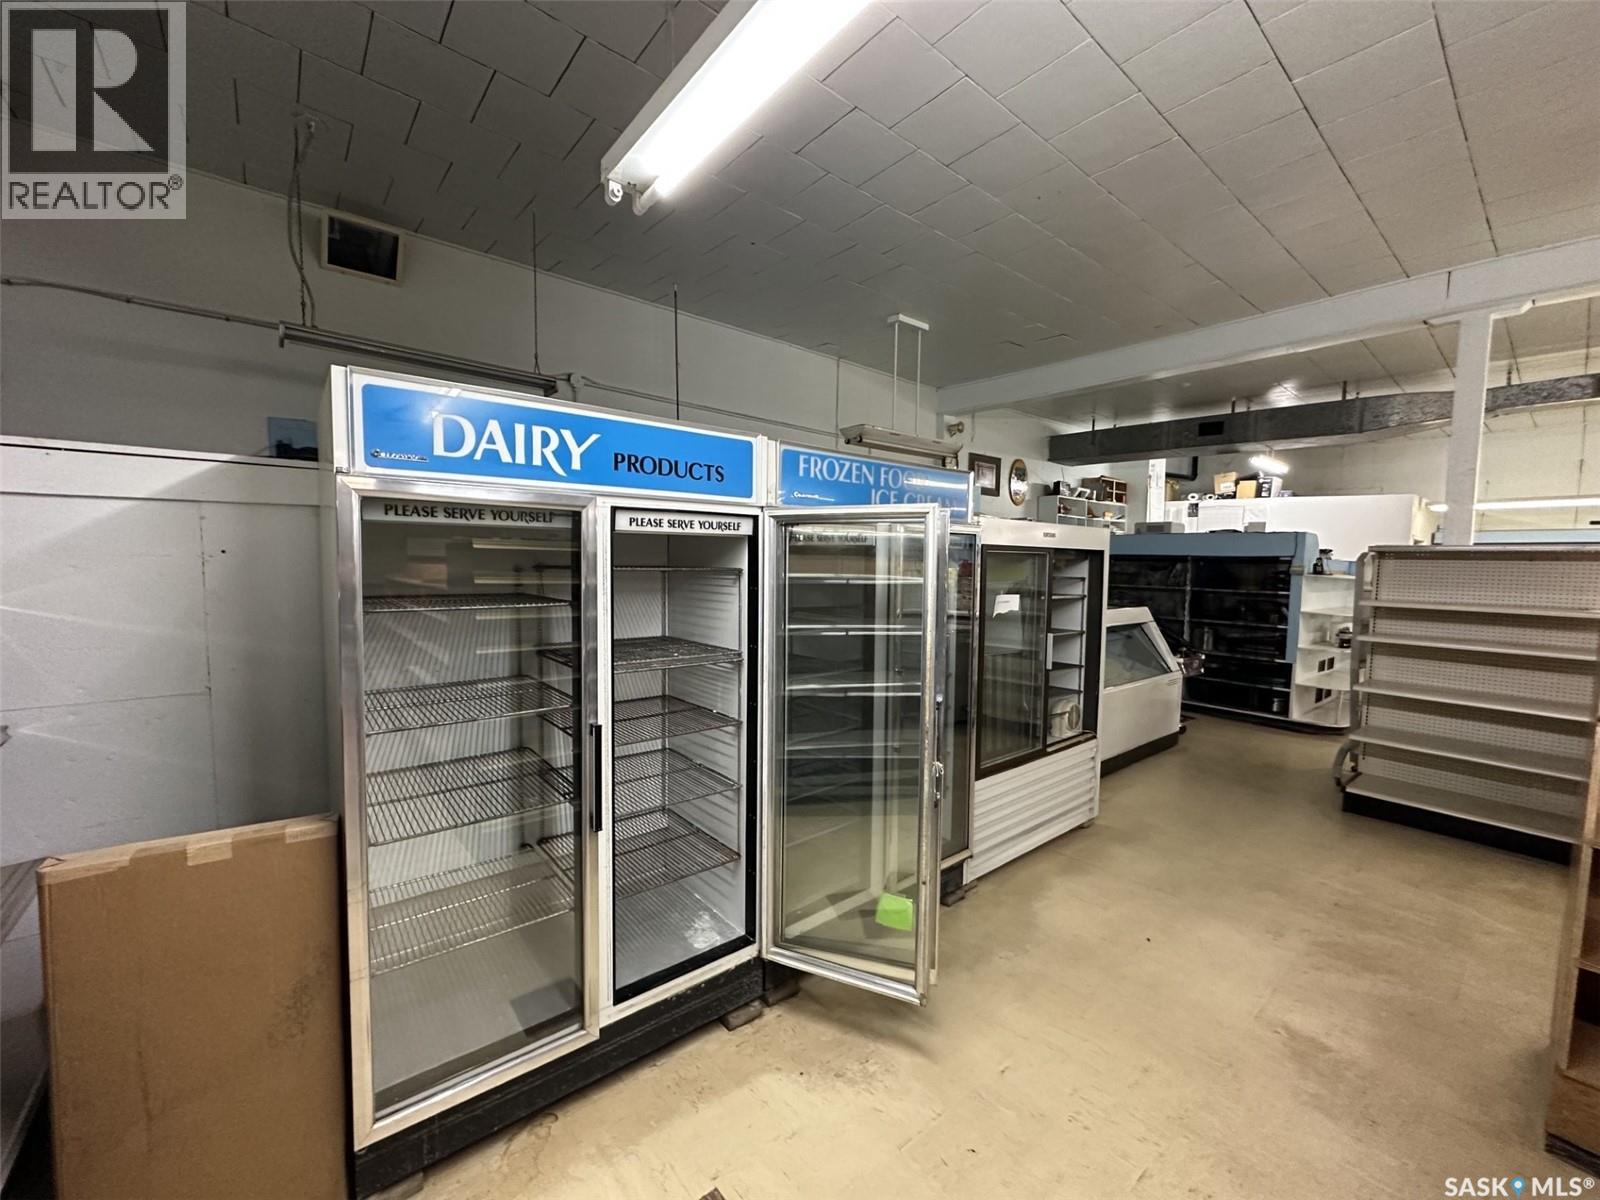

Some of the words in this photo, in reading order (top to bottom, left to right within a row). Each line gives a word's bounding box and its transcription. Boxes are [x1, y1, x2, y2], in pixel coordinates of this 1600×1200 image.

[432, 411, 601, 477] DAIRY
[613, 452, 725, 483] PRODUCTS
[798, 454, 875, 486] FROZEN
[384, 503, 438, 518] PLEASE
[443, 506, 486, 521] SERVE
[490, 509, 554, 525] YOURSELF
[628, 516, 664, 529] PLEASE
[667, 518, 695, 531] SERVE
[698, 519, 742, 533] YOURSELF
